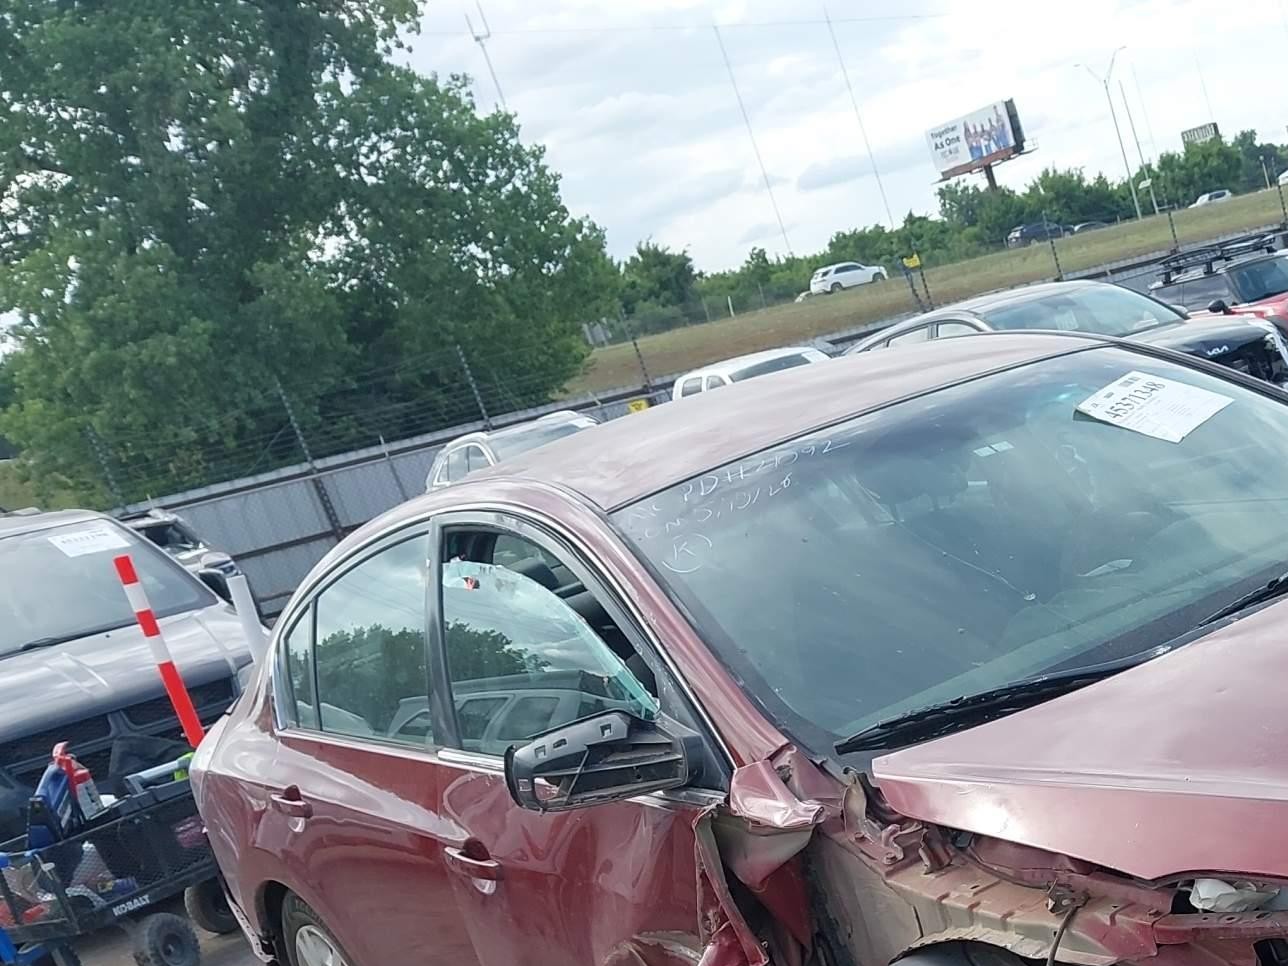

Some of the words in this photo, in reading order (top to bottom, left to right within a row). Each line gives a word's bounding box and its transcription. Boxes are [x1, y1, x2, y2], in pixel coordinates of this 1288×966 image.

[934, 141, 944, 151] As
[945, 136, 961, 146] One
[1206, 345, 1229, 356] KIA
[1104, 381, 1166, 419] 45371348
[112, 894, 150, 916] KOBALT
